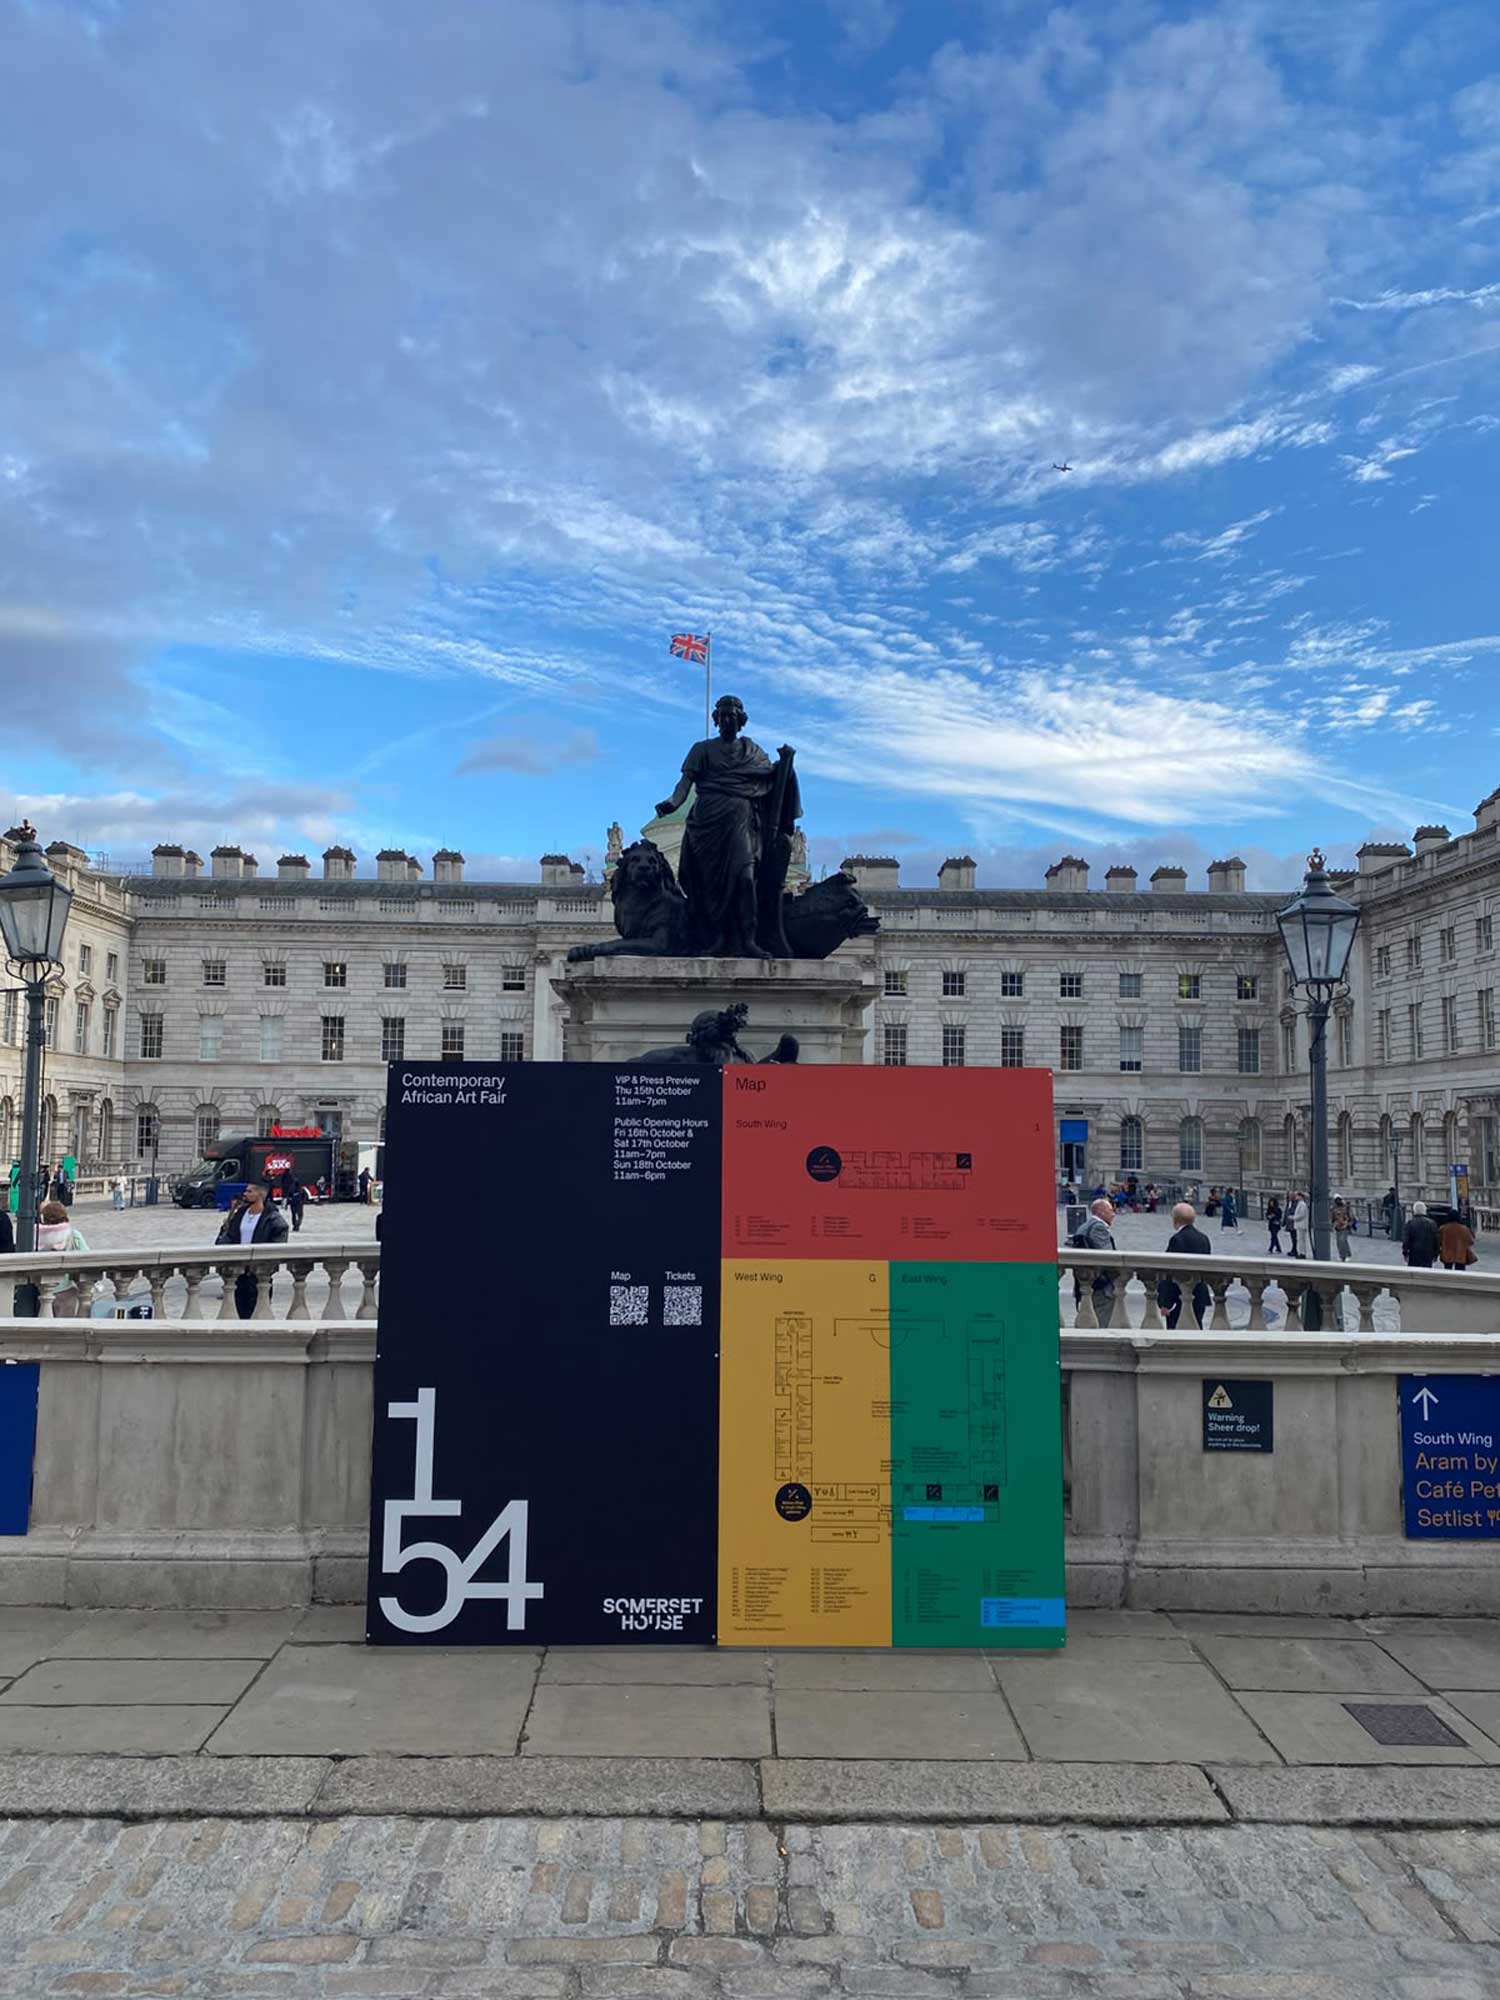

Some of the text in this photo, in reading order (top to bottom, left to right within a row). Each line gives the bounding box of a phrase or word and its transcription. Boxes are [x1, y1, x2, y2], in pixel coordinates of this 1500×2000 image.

[402, 1073, 505, 1089] Contemporary
[616, 1076, 699, 1085] VIP & Press Preview
[736, 1078, 766, 1093] Map
[616, 1086, 691, 1095] Thu 15th October
[402, 1091, 506, 1104] African Art Fair
[615, 1118, 708, 1129] Public Opening Hours
[736, 1120, 786, 1130] South Wing
[615, 1129, 693, 1138] Fri 16th October &
[614, 1139, 689, 1148] Sat 17th October
[614, 1160, 691, 1169] Sun 18th October
[611, 1272, 630, 1282] Map
[665, 1272, 695, 1280] Tickets
[735, 1272, 783, 1284] West Wing
[869, 1274, 876, 1283] G
[902, 1274, 947, 1285] East Wing
[1208, 1412, 1244, 1424] Warning
[1208, 1422, 1260, 1434] Sheer drop!
[388, 1388, 436, 1502] 1
[1414, 1432, 1492, 1448] South Wing
[1416, 1453, 1497, 1474] Aram by
[1416, 1481, 1463, 1498] Café
[1418, 1509, 1482, 1527] Setlist
[379, 1500, 544, 1633] 54
[604, 1598, 703, 1613] SOMERSET
[622, 1616, 683, 1630] HOUSE
